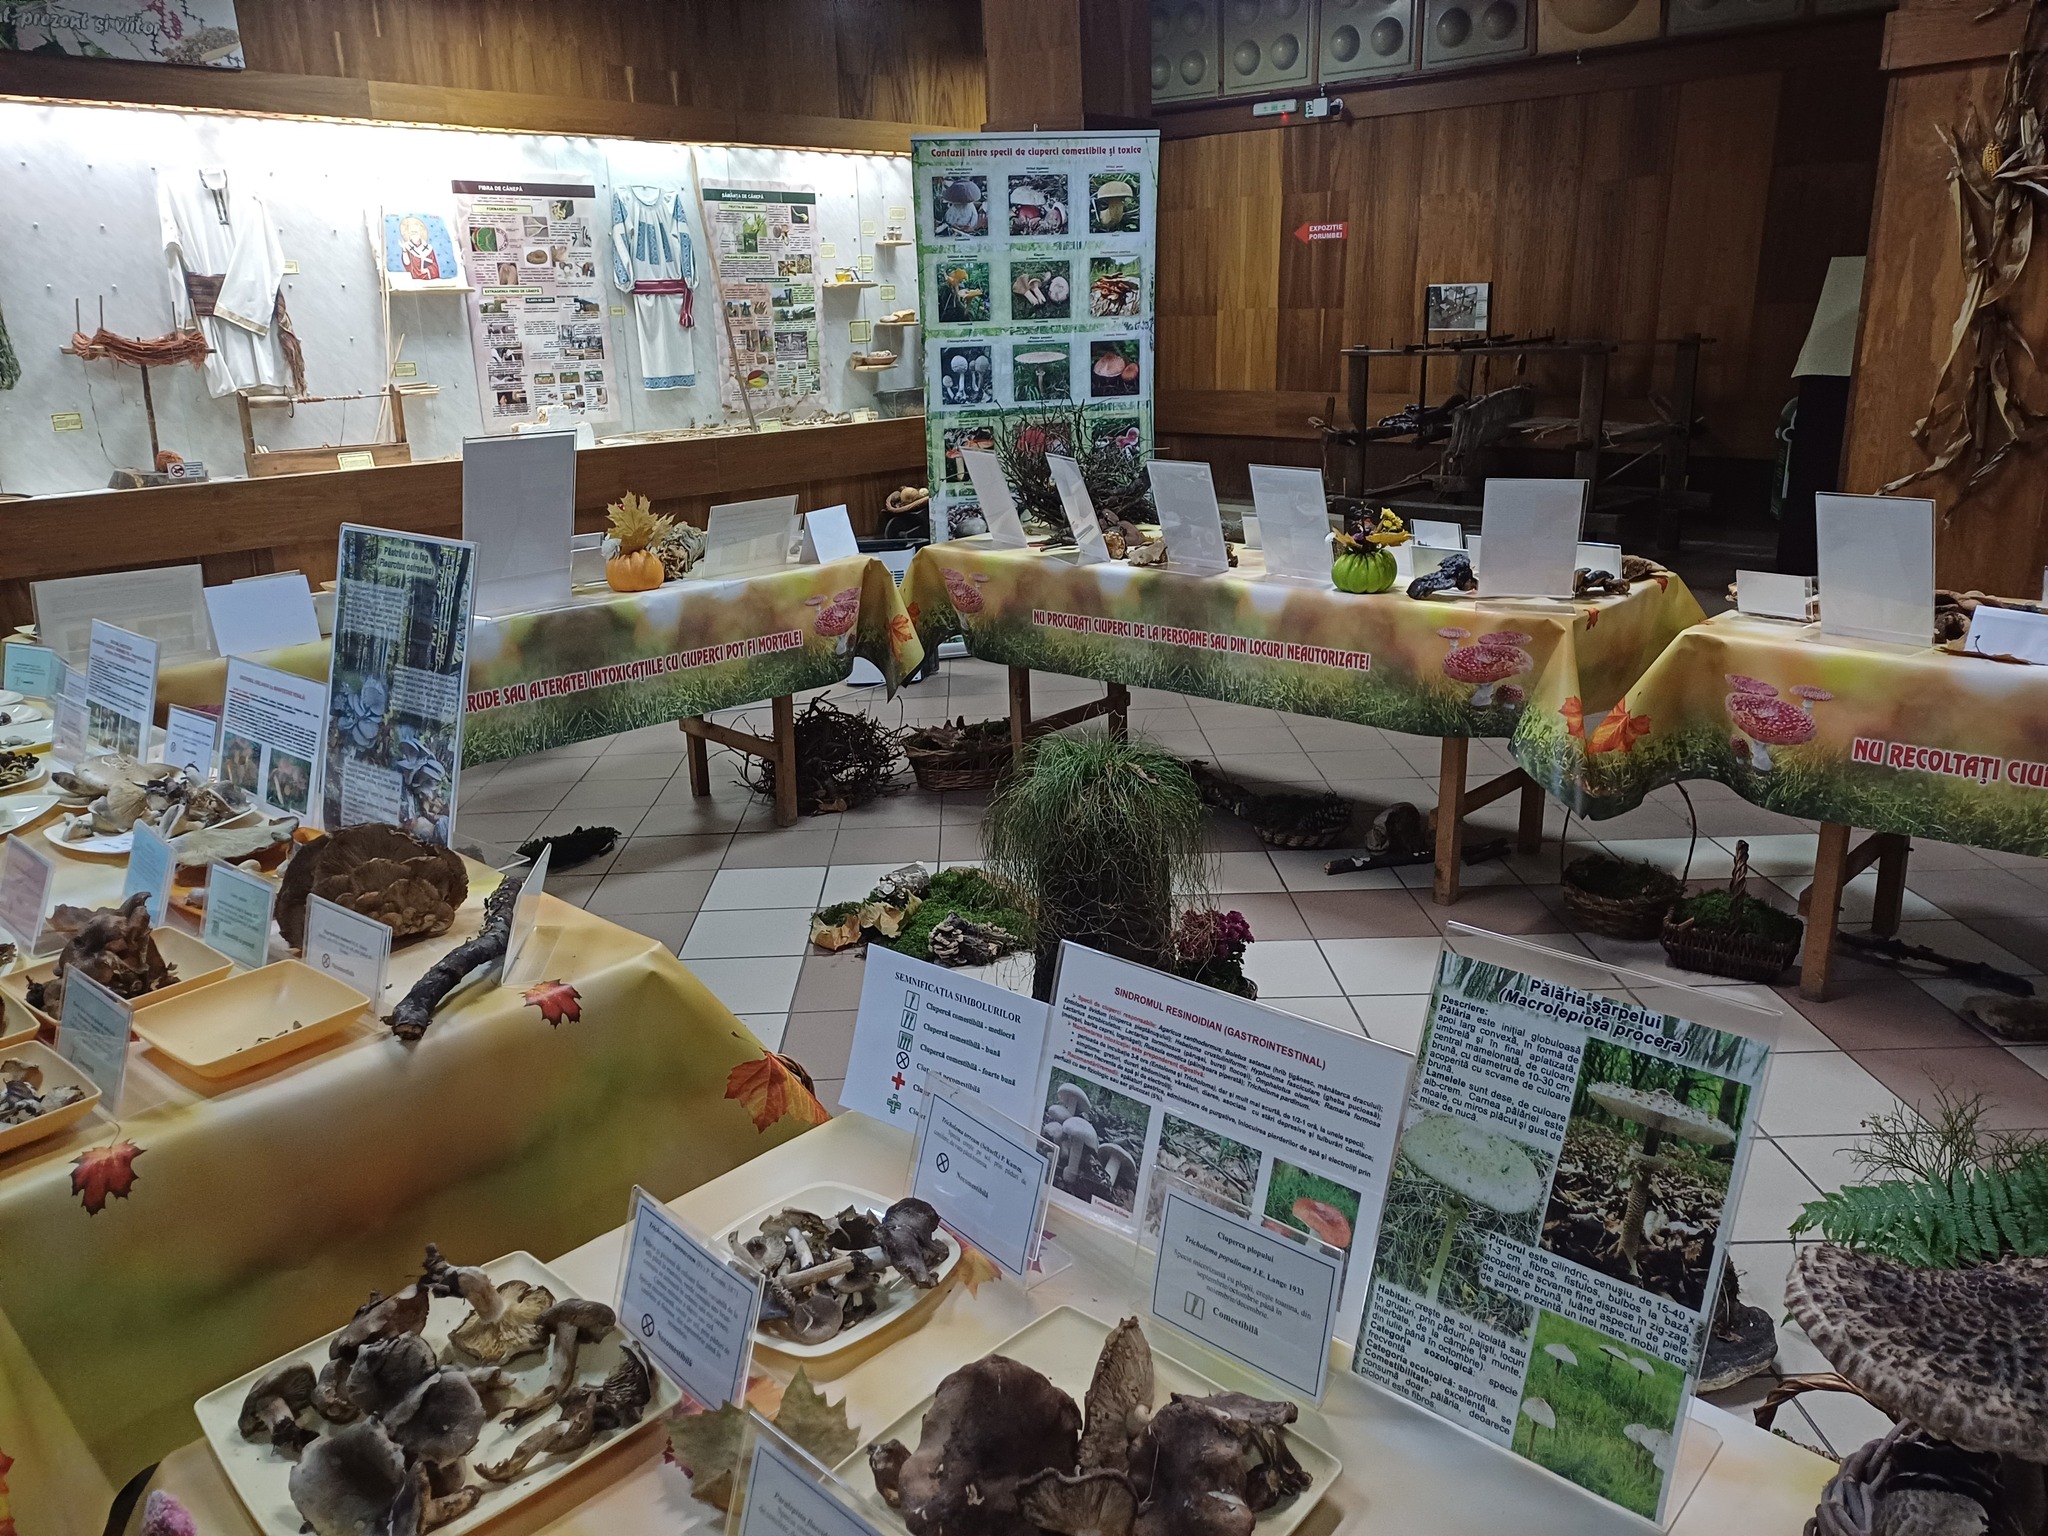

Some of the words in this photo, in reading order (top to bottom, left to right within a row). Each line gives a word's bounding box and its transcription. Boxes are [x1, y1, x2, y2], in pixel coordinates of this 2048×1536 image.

[20, 12, 89, 29] prezent
[96, 15, 110, 34] și
[115, 15, 161, 34] viitor
[931, 148, 965, 157] Confuzii
[990, 147, 1013, 159] specii
[1015, 147, 1026, 157] de
[1027, 147, 1059, 158] ciuperci
[1061, 146, 1107, 155] comestibile
[1109, 146, 1116, 157] și
[1117, 145, 1142, 154] toxice
[1308, 231, 1343, 240] PORUMBEI
[1033, 610, 1046, 625] NU
[1047, 612, 1092, 635] PROCURAȚI
[1094, 618, 1131, 638] CIUPERCI
[1133, 623, 1146, 640] DE
[1148, 625, 1160, 642] LA
[1161, 627, 1208, 648] PERSOANE
[1210, 633, 1228, 652] SAU
[1230, 635, 1248, 654] DIN
[1249, 638, 1285, 660] LOCURI
[1286, 643, 1371, 672] NEAUTORIZATE!
[466, 692, 501, 713] RUDE
[503, 686, 526, 706] SAU
[530, 673, 588, 700] ALTERATE!
[590, 657, 664, 687] INTOXICAȚIILE
[666, 654, 679, 672] CU
[682, 648, 724, 669] CIUPERCI
[726, 642, 746, 661] POT
[747, 638, 757, 657] FI
[758, 630, 803, 653] MORTALE!
[1853, 739, 1884, 764] NU
[1888, 743, 2001, 785] RECOLTAȚI
[895, 971, 953, 1000] SEMNIFICAȚIA
[954, 993, 1021, 1024] SIMBOLURILOR
[1442, 994, 1489, 1016] Descriere:
[1497, 986, 1615, 1035] (Macrolepiota
[1613, 1021, 1690, 1059] procera)
[1528, 978, 1662, 1033] Pălăria-șarpelui
[1114, 987, 1164, 1012] SINDROMUL
[1165, 1005, 1223, 1032] RESINOIDIAN
[1223, 1026, 1326, 1070] (GASTROINTESTINAL)
[1435, 1023, 1470, 1040] umbrelă
[1475, 1036, 1484, 1045] și
[1489, 1038, 1499, 1049] în
[1504, 1043, 1524, 1057] final
[1529, 1053, 1576, 1075] aplatizată,
[1437, 1014, 1457, 1026] apoi
[1459, 1019, 1477, 1034] larg
[1479, 1027, 1519, 1047] convexă,
[1523, 1039, 1533, 1050] în
[1536, 1044, 1563, 1060] formă
[1566, 1054, 1580, 1066] de
[1439, 1003, 1471, 1021] Pălăria
[1476, 1016, 1496, 1028] este
[1501, 1022, 1526, 1037] inițial
[1530, 1033, 1581, 1055] globuloasă
[1427, 1057, 1454, 1074] brună.
[1429, 1050, 1469, 1069] acoperită
[1471, 1064, 1483, 1074] cu
[1484, 1069, 1520, 1086] scvame
[1521, 1080, 1534, 1091] de
[1536, 1086, 1571, 1103] culoare
[1431, 1039, 1458, 1057] brună,
[1460, 1051, 1472, 1060] cu
[1472, 1054, 1512, 1074] diametru
[1513, 1067, 1526, 1078] de
[1433, 1032, 1463, 1047] central
[1465, 1042, 1522, 1067] mamelonată,
[1525, 1061, 1538, 1072] de
[1540, 1067, 1575, 1084] culoare
[1419, 1095, 1440, 1109] miez
[1441, 1103, 1453, 1113] de
[1454, 1108, 1478, 1122] nucă.
[1421, 1086, 1450, 1104] moale,
[1451, 1097, 1463, 1107] cu
[1463, 1101, 1489, 1116] miros
[1489, 1110, 1518, 1126] plăcut
[1518, 1120, 1528, 1130] și
[1527, 1124, 1549, 1138] gust
[1549, 1131, 1562, 1142] de
[1423, 1077, 1463, 1097] alb-crem.
[1505, 1106, 1540, 1123] pălăriei
[1544, 1119, 1564, 1132] este
[1425, 1067, 1466, 1088] Lamelele
[1468, 1083, 1489, 1096] sunt
[1490, 1090, 1515, 1106] dese,
[1517, 1099, 1530, 1110] de
[1531, 1105, 1566, 1123] culoare
[1185, 1235, 1218, 1257] Tricholoma
[1217, 1252, 1252, 1272] populinum
[1252, 1267, 1266, 1280] J.E.
[1266, 1273, 1288, 1289] Lange
[1288, 1283, 1305, 1296] 1933
[1217, 1231, 1246, 1250] Ciuperca
[1246, 1246, 1274, 1263] plopului
[1483, 1253, 1521, 1275] acoperit
[1522, 1269, 1535, 1280] de
[1535, 1275, 1573, 1296] scvame
[1575, 1290, 1594, 1305] fine
[1594, 1300, 1635, 1322] dispuse
[1637, 1314, 1647, 1329] în
[1489, 1232, 1526, 1256] Piciorul
[1528, 1251, 1549, 1265] este
[1551, 1261, 1590, 1283] cilindric,
[1593, 1278, 1635, 1301] cenușiu,
[1638, 1295, 1652, 1307] de
[1688, 1316, 1696, 1326] x
[1212, 1306, 1259, 1336] Comestibilă
[1564, 1275, 1601, 1298] fistulos,
[1607, 1292, 1641, 1313] bulbos
[1647, 1308, 1658, 1321] la
[1664, 1314, 1692, 1336] bază,
